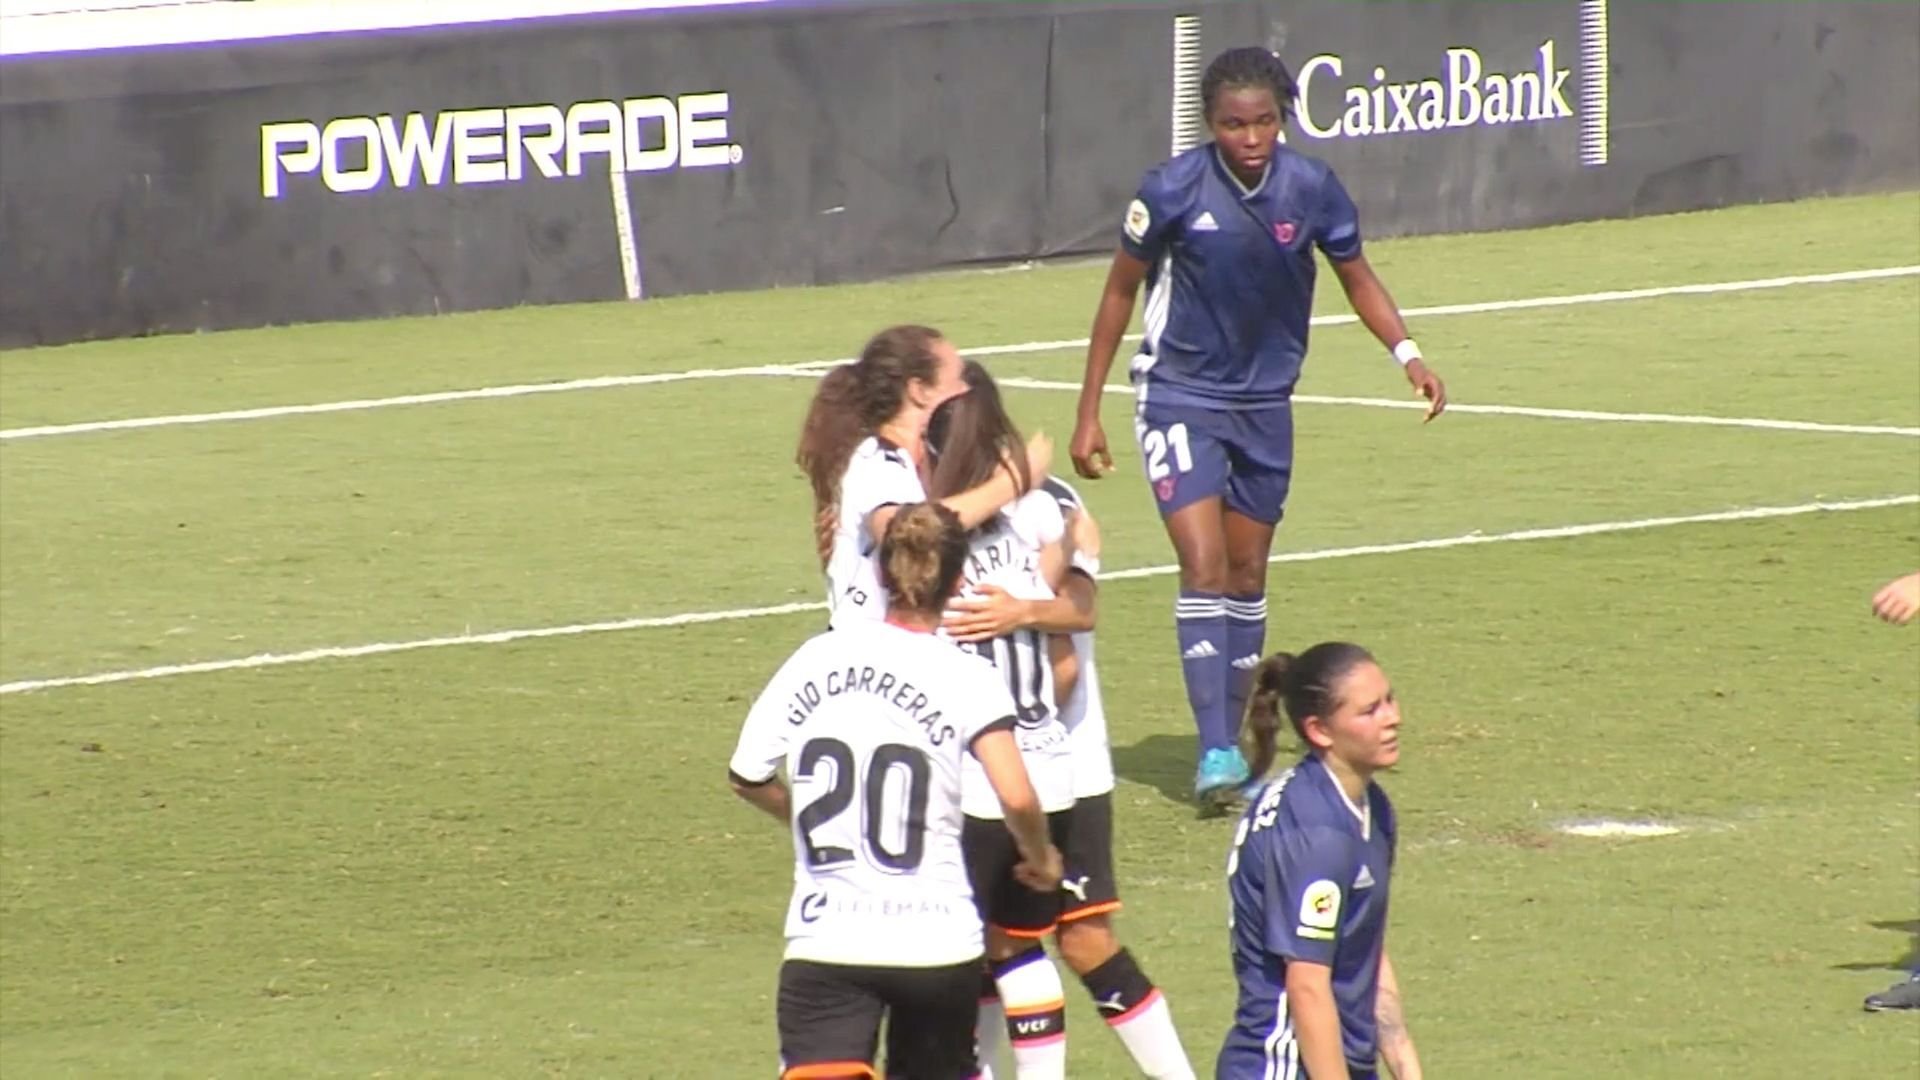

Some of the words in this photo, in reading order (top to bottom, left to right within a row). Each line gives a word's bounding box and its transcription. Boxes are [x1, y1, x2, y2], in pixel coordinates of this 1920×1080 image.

[1295, 39, 1573, 139] CaixaBank
[261, 93, 731, 197] POWERADE
[1144, 423, 1193, 482] 21
[788, 681, 821, 727] GIO
[828, 666, 955, 747] CARRERAS
[798, 737, 931, 871] 20
[1016, 1018, 1049, 1034] VCF
